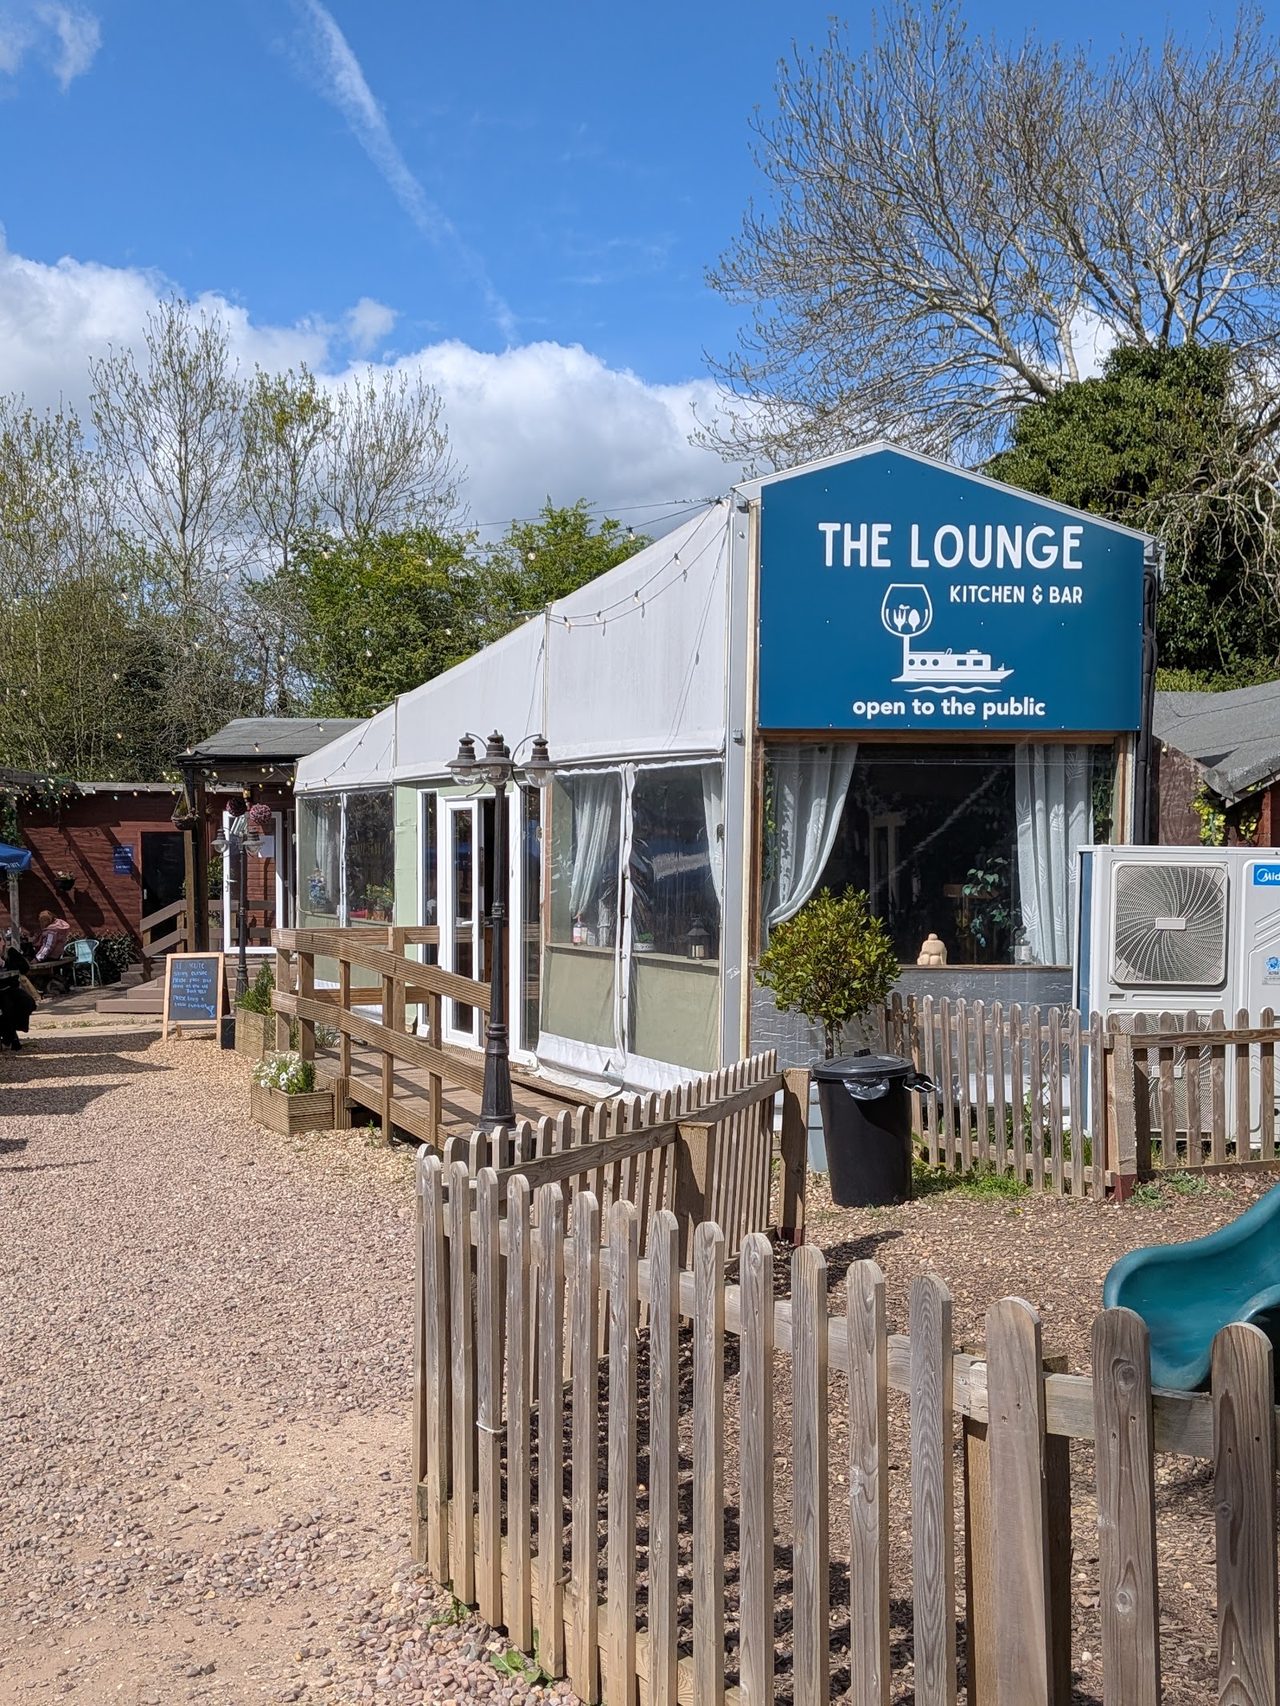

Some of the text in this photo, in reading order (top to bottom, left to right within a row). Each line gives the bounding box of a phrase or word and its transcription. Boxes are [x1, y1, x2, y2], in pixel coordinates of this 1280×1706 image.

[818, 522, 1084, 570] THE LOUNGE
[950, 584, 1083, 604] KITCHEN & BAR
[852, 697, 1046, 720] open to the public
